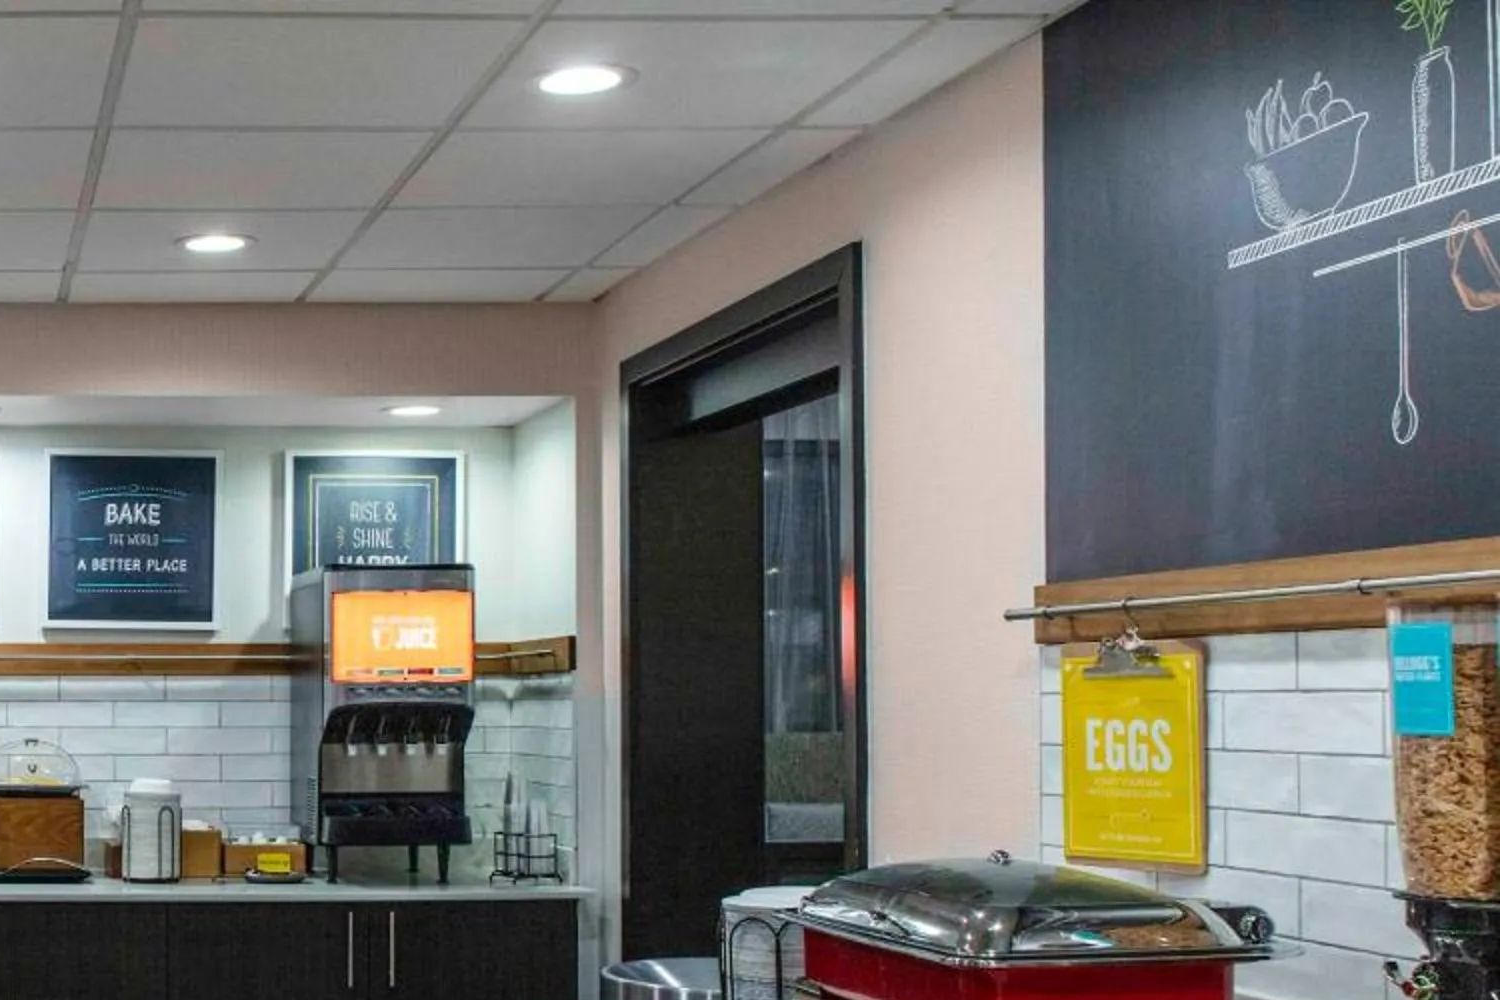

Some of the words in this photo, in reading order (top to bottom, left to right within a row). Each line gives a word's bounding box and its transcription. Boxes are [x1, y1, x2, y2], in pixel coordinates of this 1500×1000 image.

[104, 503, 161, 526] BAKE
[349, 500, 381, 523] RISE
[385, 501, 397, 522] &
[353, 527, 394, 549] SHINE
[77, 558, 87, 571] A
[92, 558, 141, 571] BETTER
[147, 559, 187, 573] PLACE
[1085, 717, 1173, 773] EGGS
